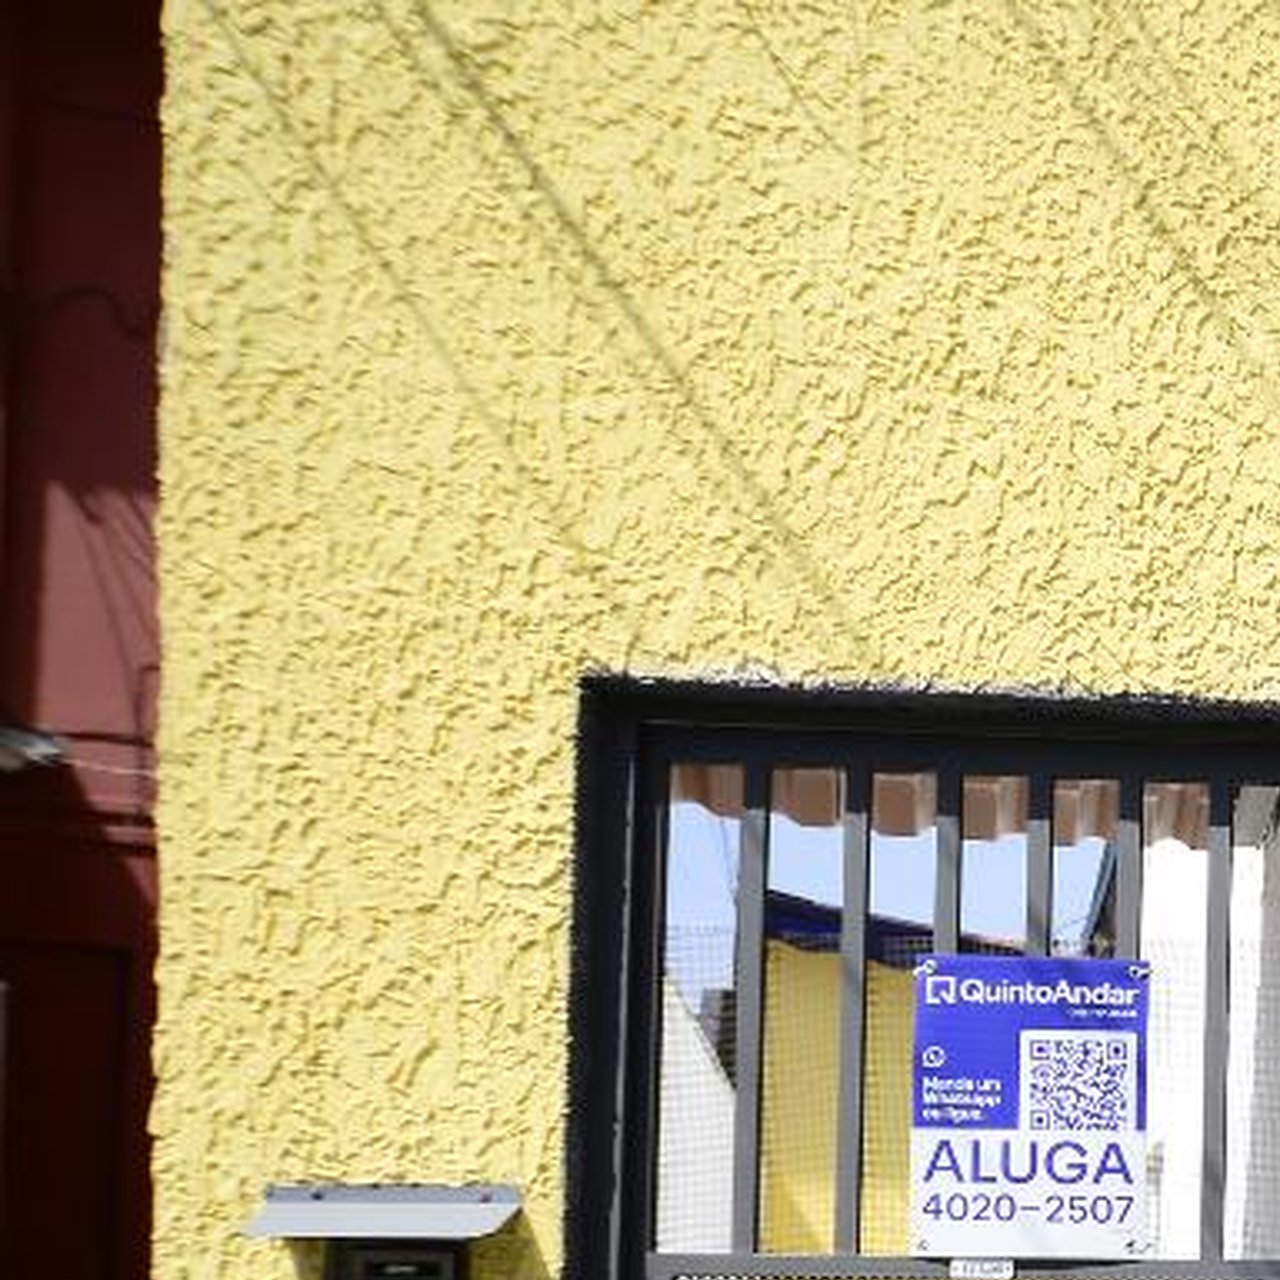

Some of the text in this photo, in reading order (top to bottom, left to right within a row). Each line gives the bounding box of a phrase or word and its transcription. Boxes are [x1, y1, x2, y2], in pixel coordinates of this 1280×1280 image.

[960, 978, 1141, 1006] QuintoAndar
[923, 1138, 1134, 1185] ALUGA
[922, 1194, 1135, 1224] 4020-2507
